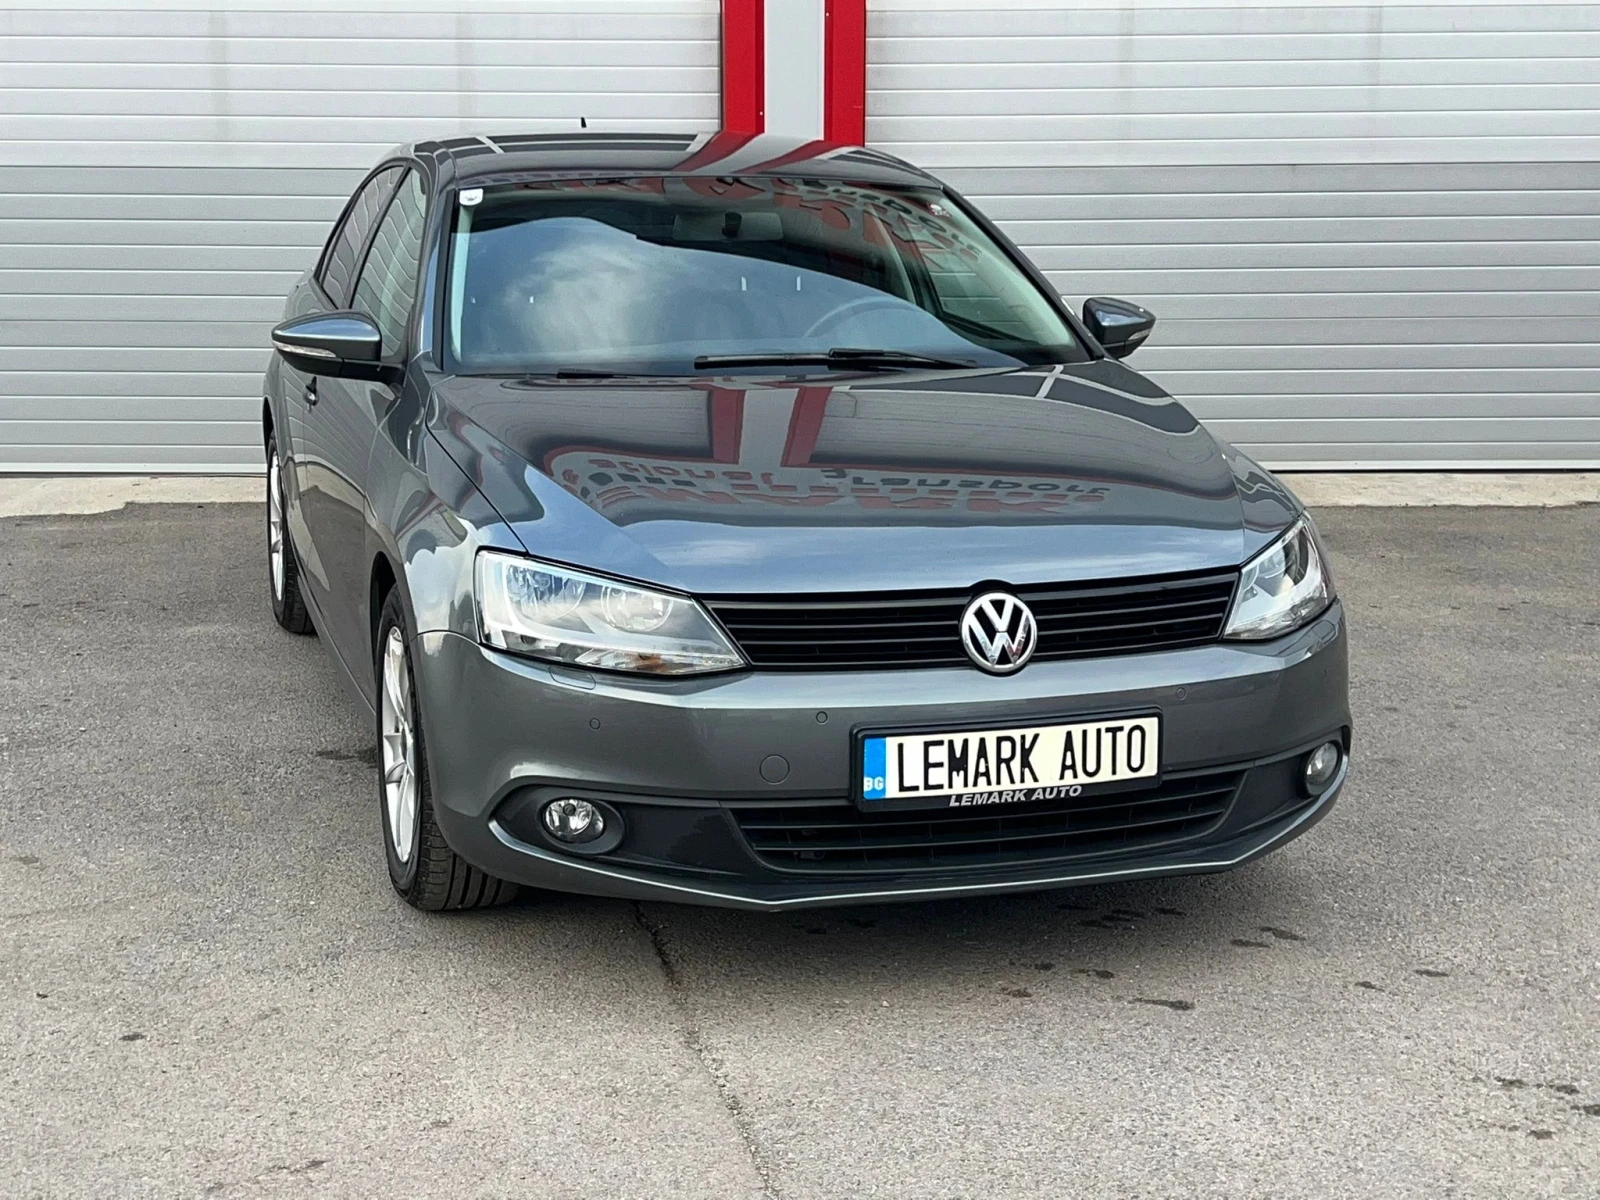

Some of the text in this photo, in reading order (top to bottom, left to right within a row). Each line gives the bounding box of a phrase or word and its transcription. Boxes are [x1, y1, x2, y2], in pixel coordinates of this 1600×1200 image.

[961, 592, 1037, 672] VW
[897, 724, 1146, 792] LEMARK AUTO
[863, 776, 884, 791] BG
[949, 785, 1083, 807] LEMARK AUTO
